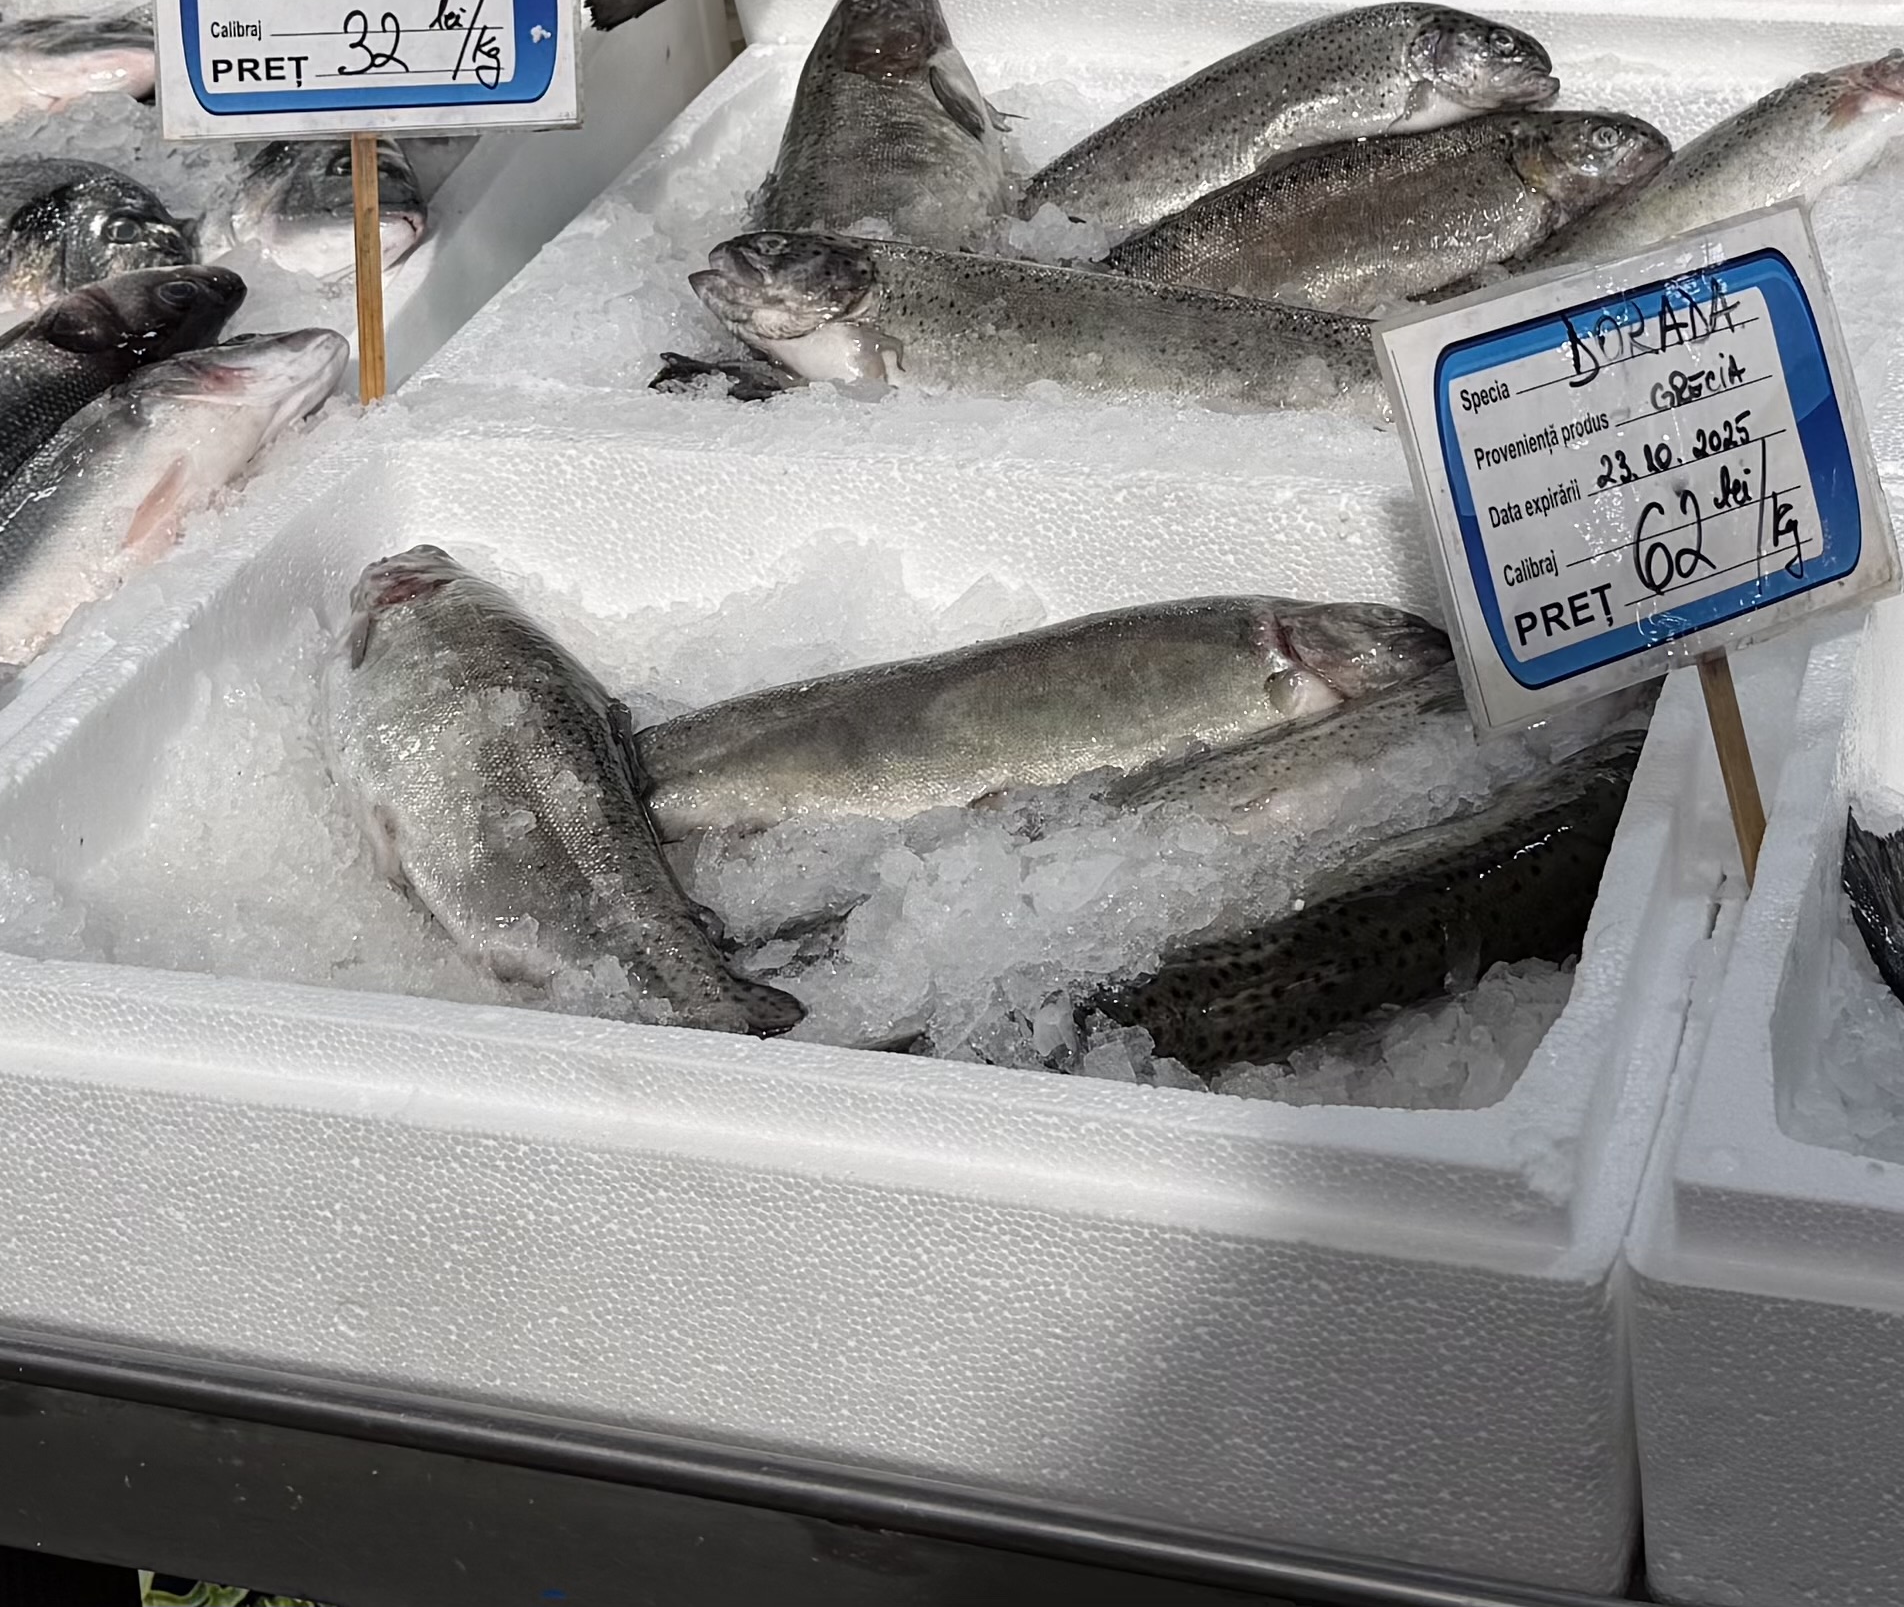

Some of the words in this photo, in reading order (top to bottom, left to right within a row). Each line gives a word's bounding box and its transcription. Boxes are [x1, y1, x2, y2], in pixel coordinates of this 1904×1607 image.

[211, 19, 262, 41] Calibraj
[212, 55, 309, 87] PREȚ
[338, 9, 410, 75] 32
[1459, 379, 1511, 414] Specia
[1561, 277, 1741, 388] DORADA
[1473, 428, 1560, 471] Proveniență
[1560, 411, 1610, 451] produs
[1651, 352, 1747, 411] GRECIA
[1488, 500, 1525, 530] Data
[1526, 480, 1582, 525] expirării
[1595, 410, 1753, 490] 23.10.2025
[1503, 549, 1559, 587] Calibraj
[1514, 582, 1615, 647] PREȚ
[1633, 489, 1718, 595] 62
